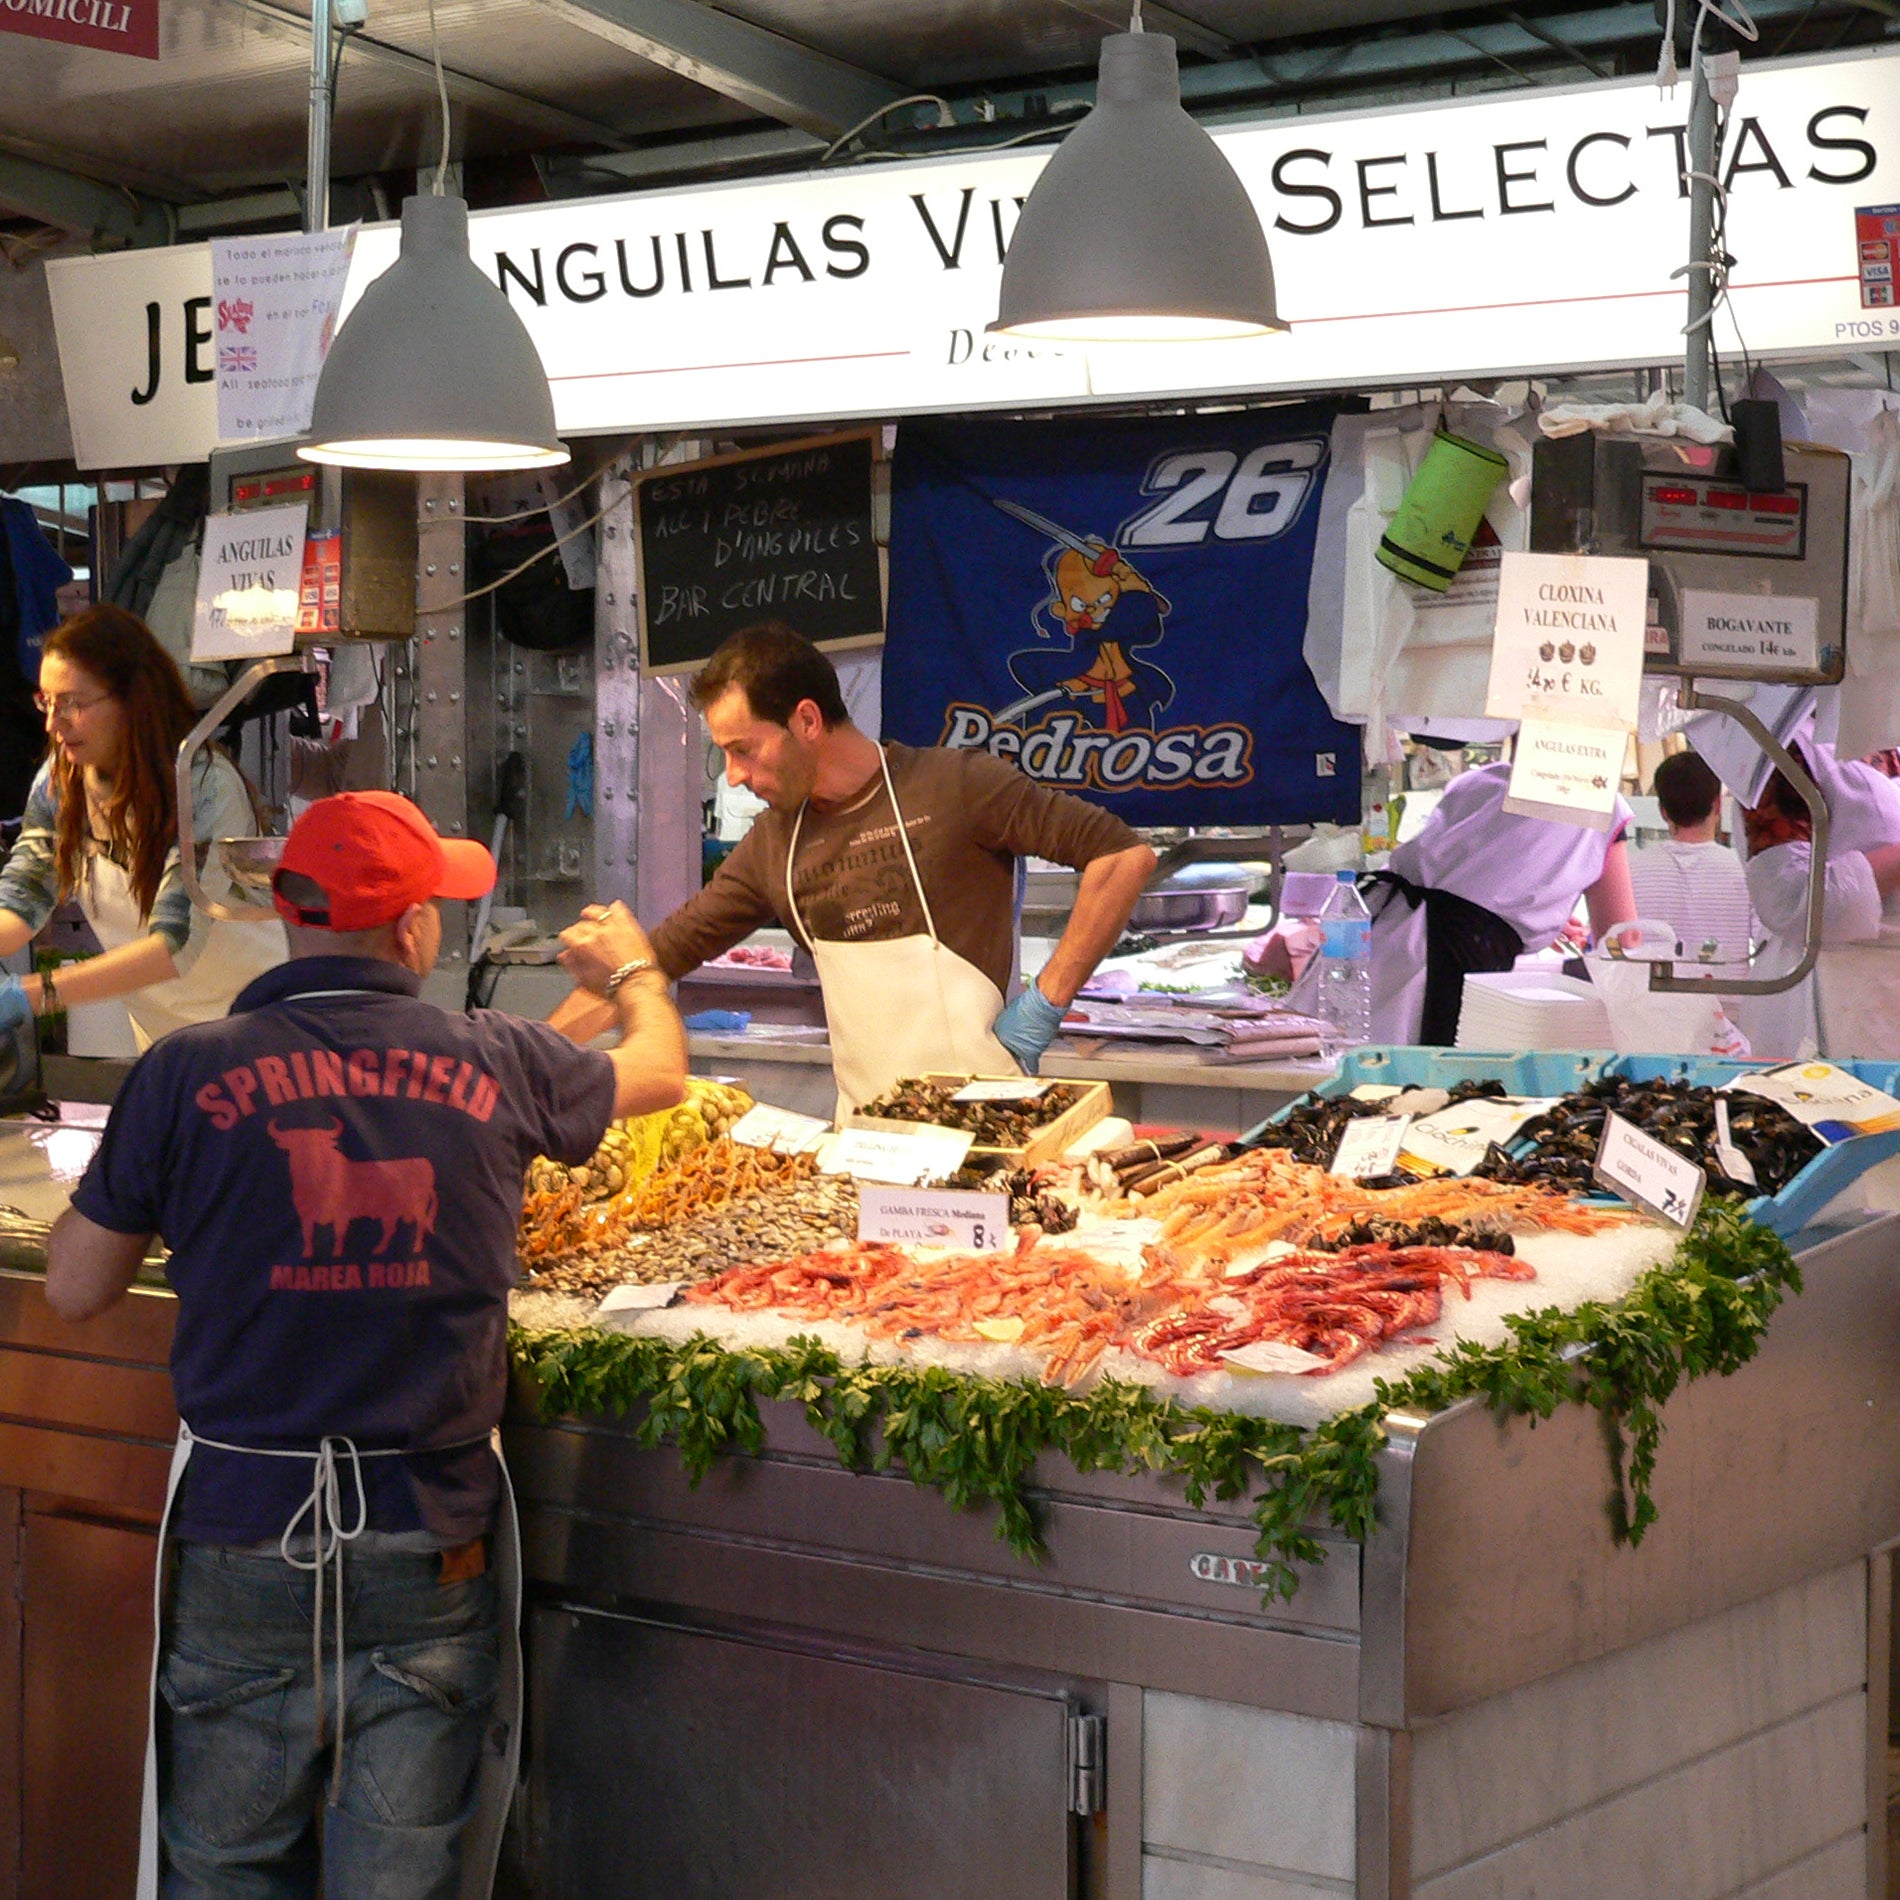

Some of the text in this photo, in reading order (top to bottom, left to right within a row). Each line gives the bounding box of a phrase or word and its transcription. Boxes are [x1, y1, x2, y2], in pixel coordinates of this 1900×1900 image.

[495, 213, 870, 308] NGUILAS
[1270, 104, 1878, 236] SELECTAS
[1834, 321, 1884, 339] PTOS
[652, 477, 708, 502] ESTA
[1128, 440, 1325, 548] 26
[217, 534, 295, 565] ANGUILAS
[231, 569, 275, 591] VIVAS
[1538, 583, 1605, 605] CLOXINA
[654, 570, 857, 626] BAR CENTRAL
[1523, 608, 1618, 633] VALENCIANA
[1706, 617, 1793, 635] BOGAVANTE
[945, 706, 1246, 784] Pedrosa
[195, 1047, 503, 1131] SPRINGFIELD
[880, 1206, 914, 1218] GAMBA
[915, 1207, 950, 1219] FRESCA
[270, 1260, 431, 1291] MAREA ROJA
